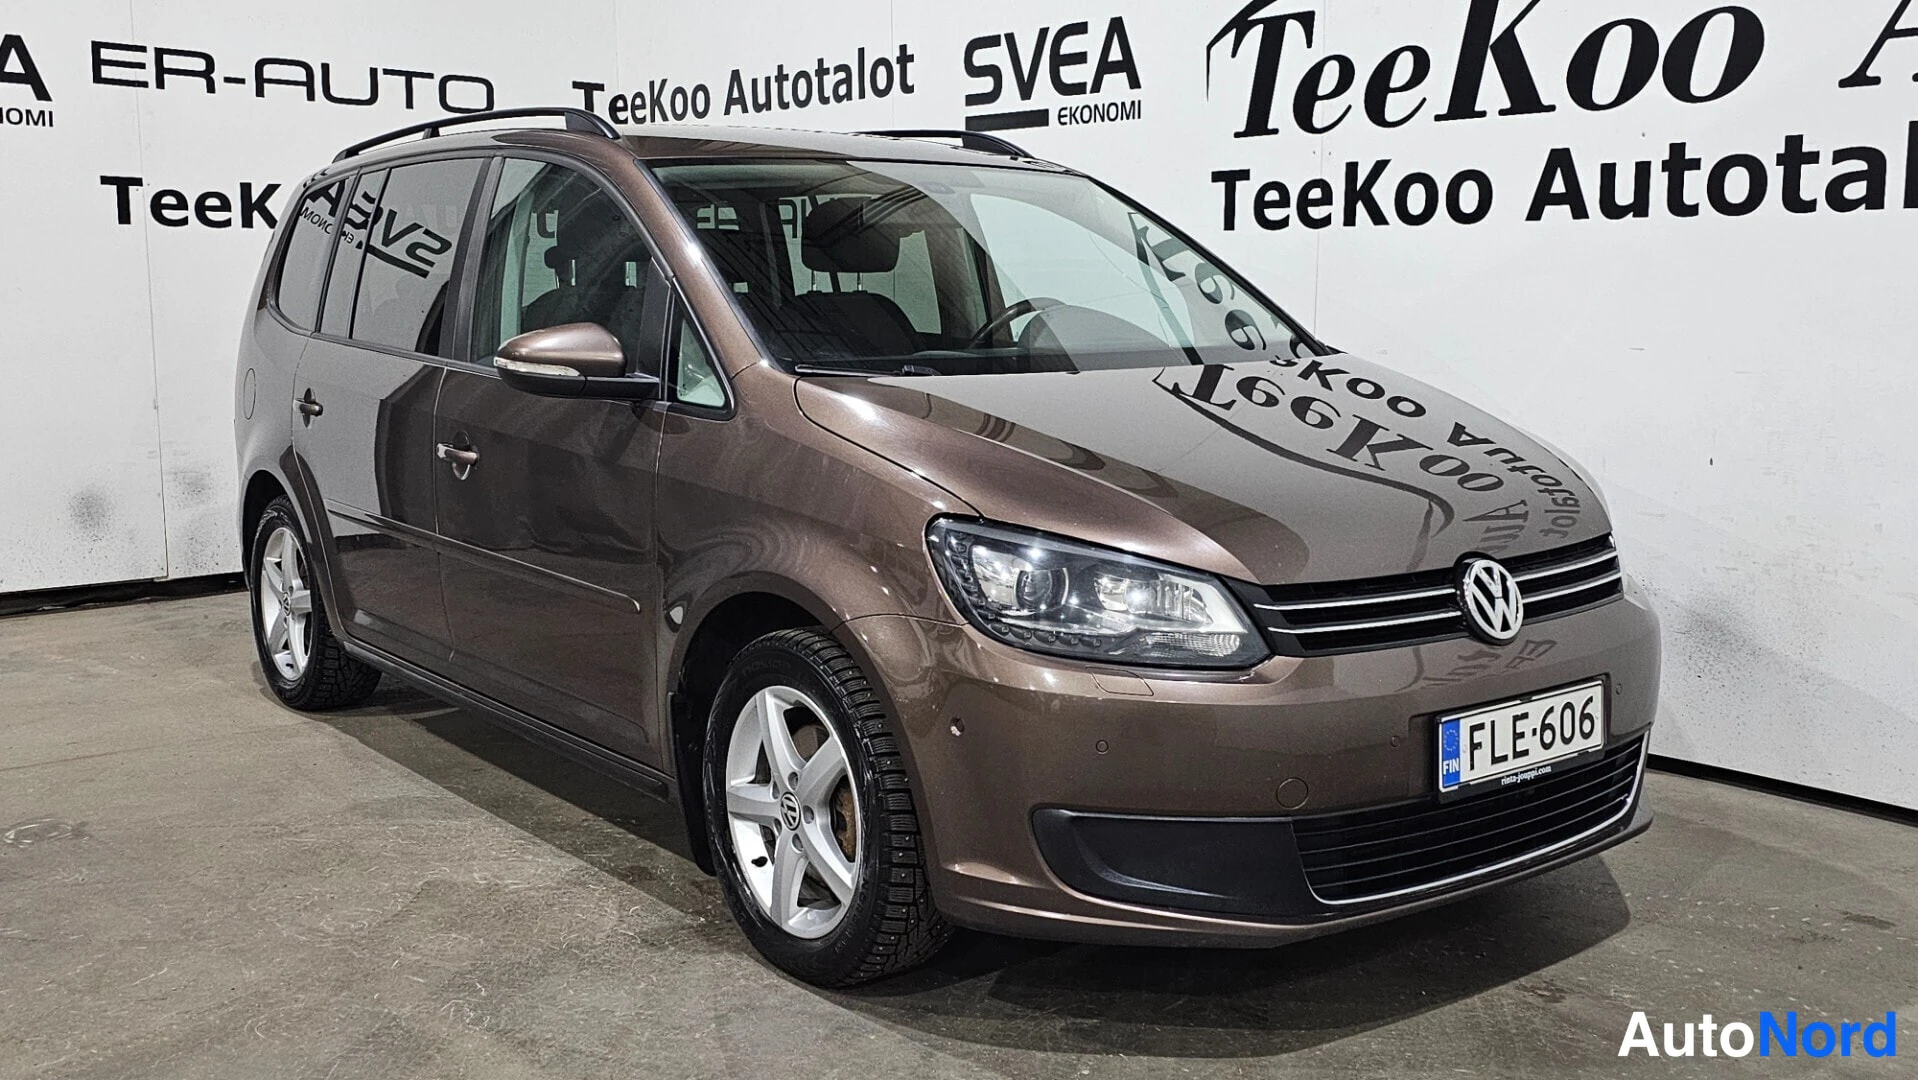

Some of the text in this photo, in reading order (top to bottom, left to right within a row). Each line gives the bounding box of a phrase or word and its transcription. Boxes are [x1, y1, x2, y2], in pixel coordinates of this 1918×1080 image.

[90, 40, 495, 114] ER-AUTO
[571, 43, 915, 125] TeeKoo Autotalot
[963, 15, 1142, 108] SVEA
[1230, 0, 1765, 139] TeeKoo
[0, 106, 54, 128] OMI
[1057, 99, 1142, 126] EKONOMI
[1211, 158, 1494, 231] TeeKoo
[1442, 757, 1460, 776] FIN
[1469, 695, 1596, 771] FLE-606
